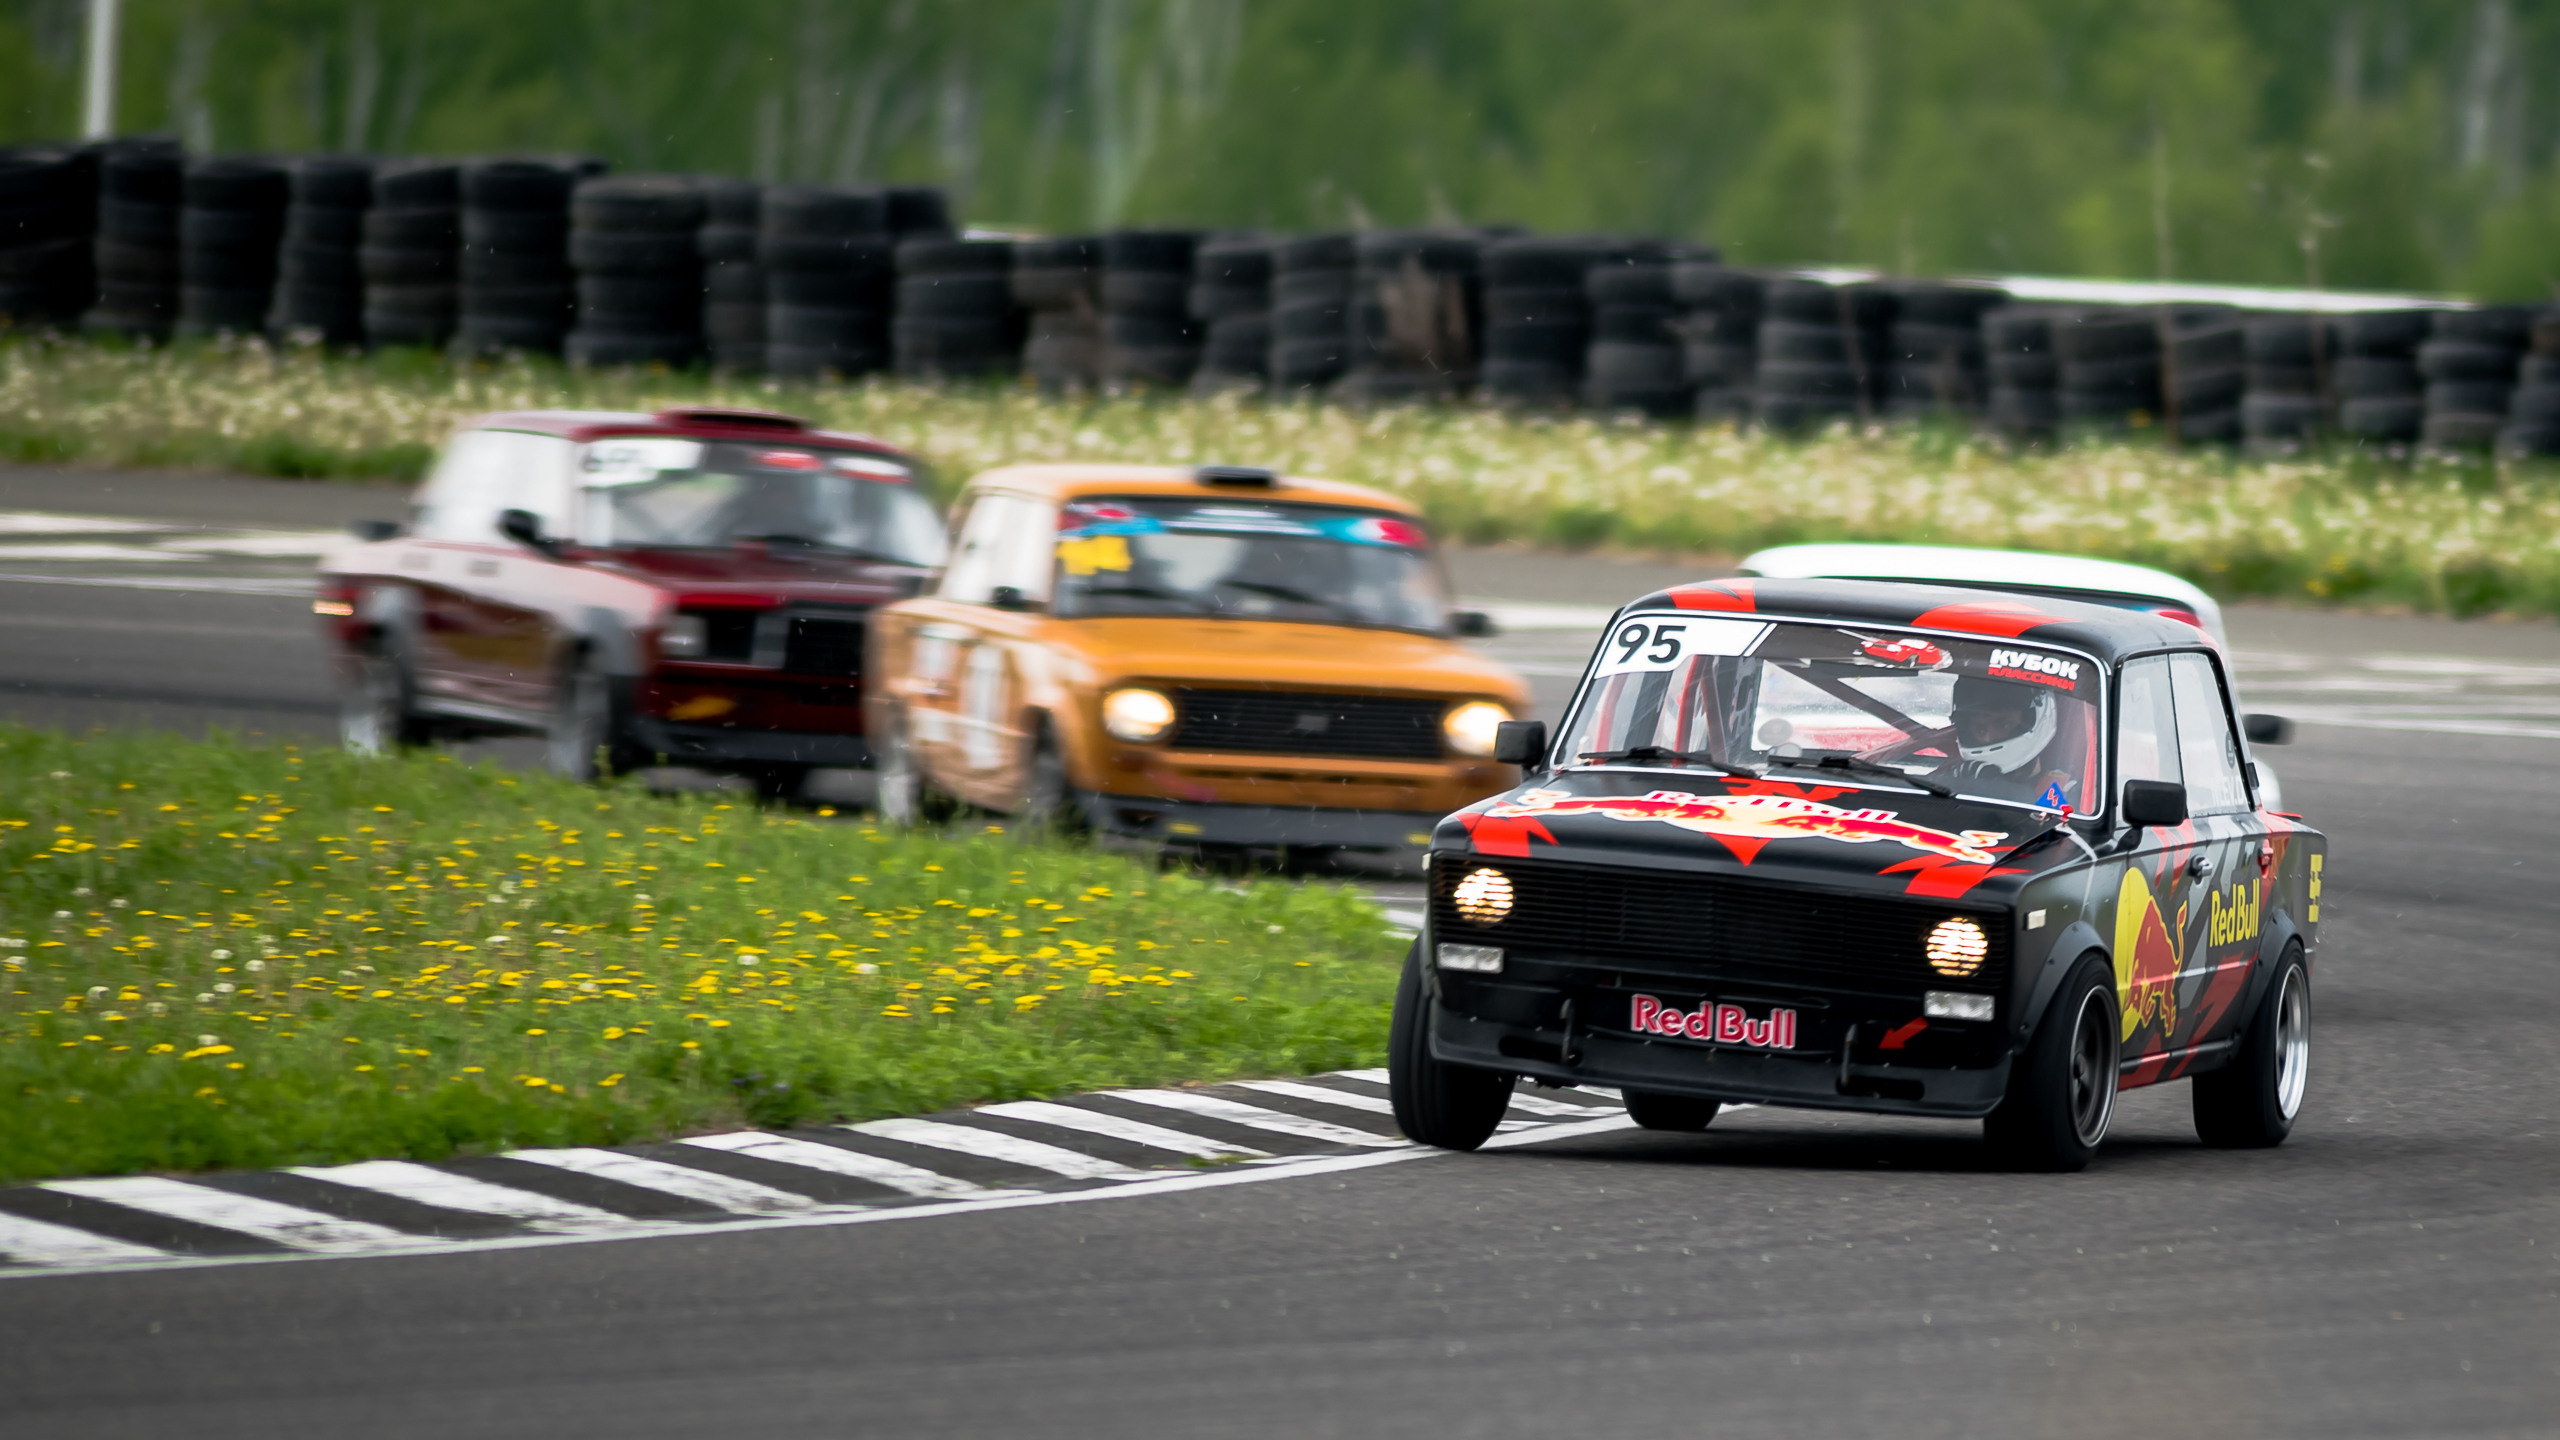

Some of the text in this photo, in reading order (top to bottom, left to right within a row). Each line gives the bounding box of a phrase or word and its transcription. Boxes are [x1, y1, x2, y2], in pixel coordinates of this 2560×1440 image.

[1617, 624, 1687, 664] 95
[1987, 666, 2076, 691] КЛАССИКИ
[1989, 648, 2080, 681] КУБОК
[2209, 877, 2260, 948] Red Bull
[1631, 993, 1796, 1049] Red Bull
